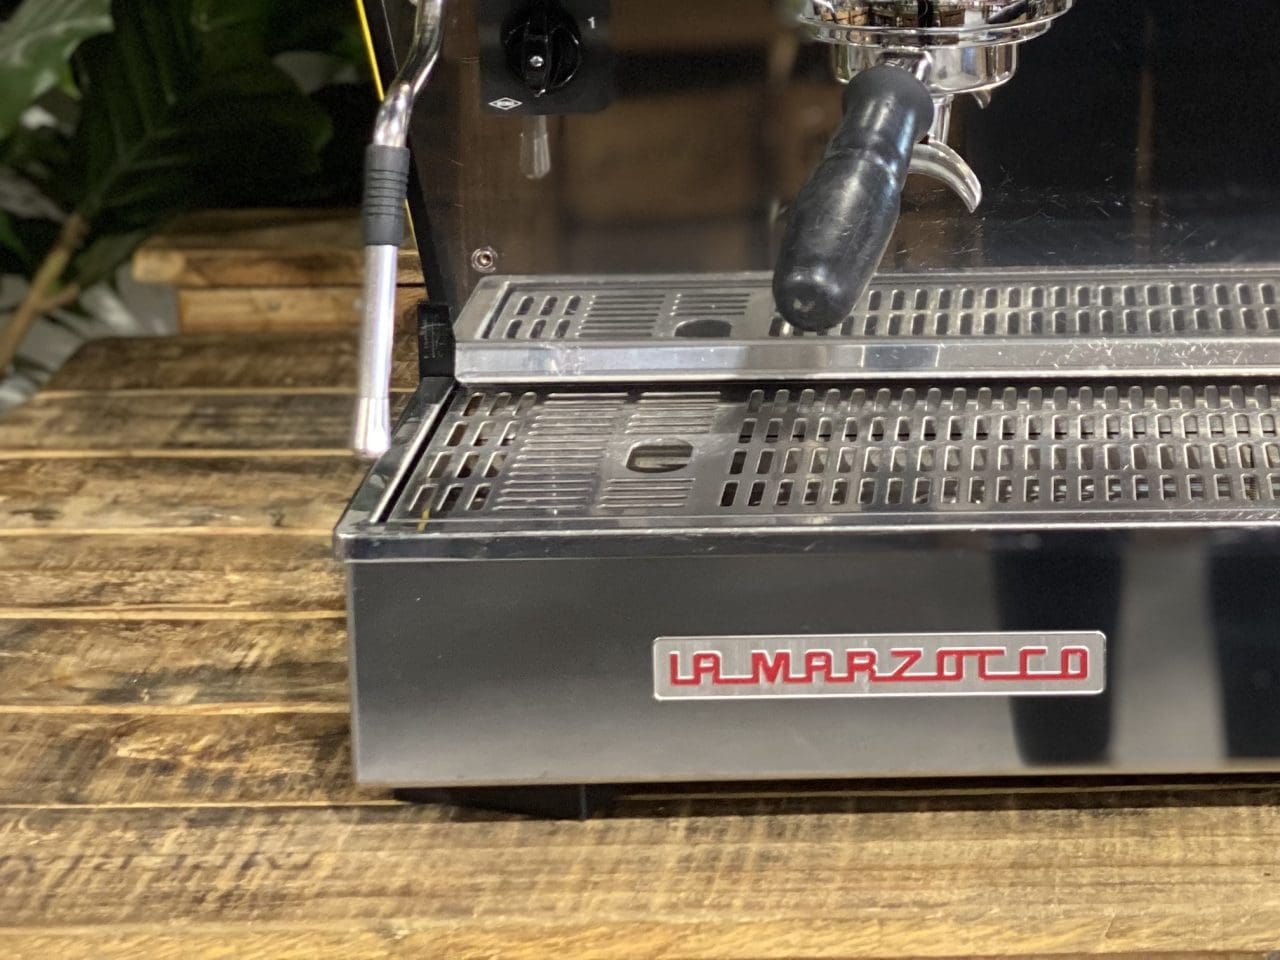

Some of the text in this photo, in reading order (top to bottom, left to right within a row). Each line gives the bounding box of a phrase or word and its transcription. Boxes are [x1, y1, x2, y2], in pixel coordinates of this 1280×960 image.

[587, 16, 596, 29] 1
[669, 646, 1089, 686] LA MARZOCCO
